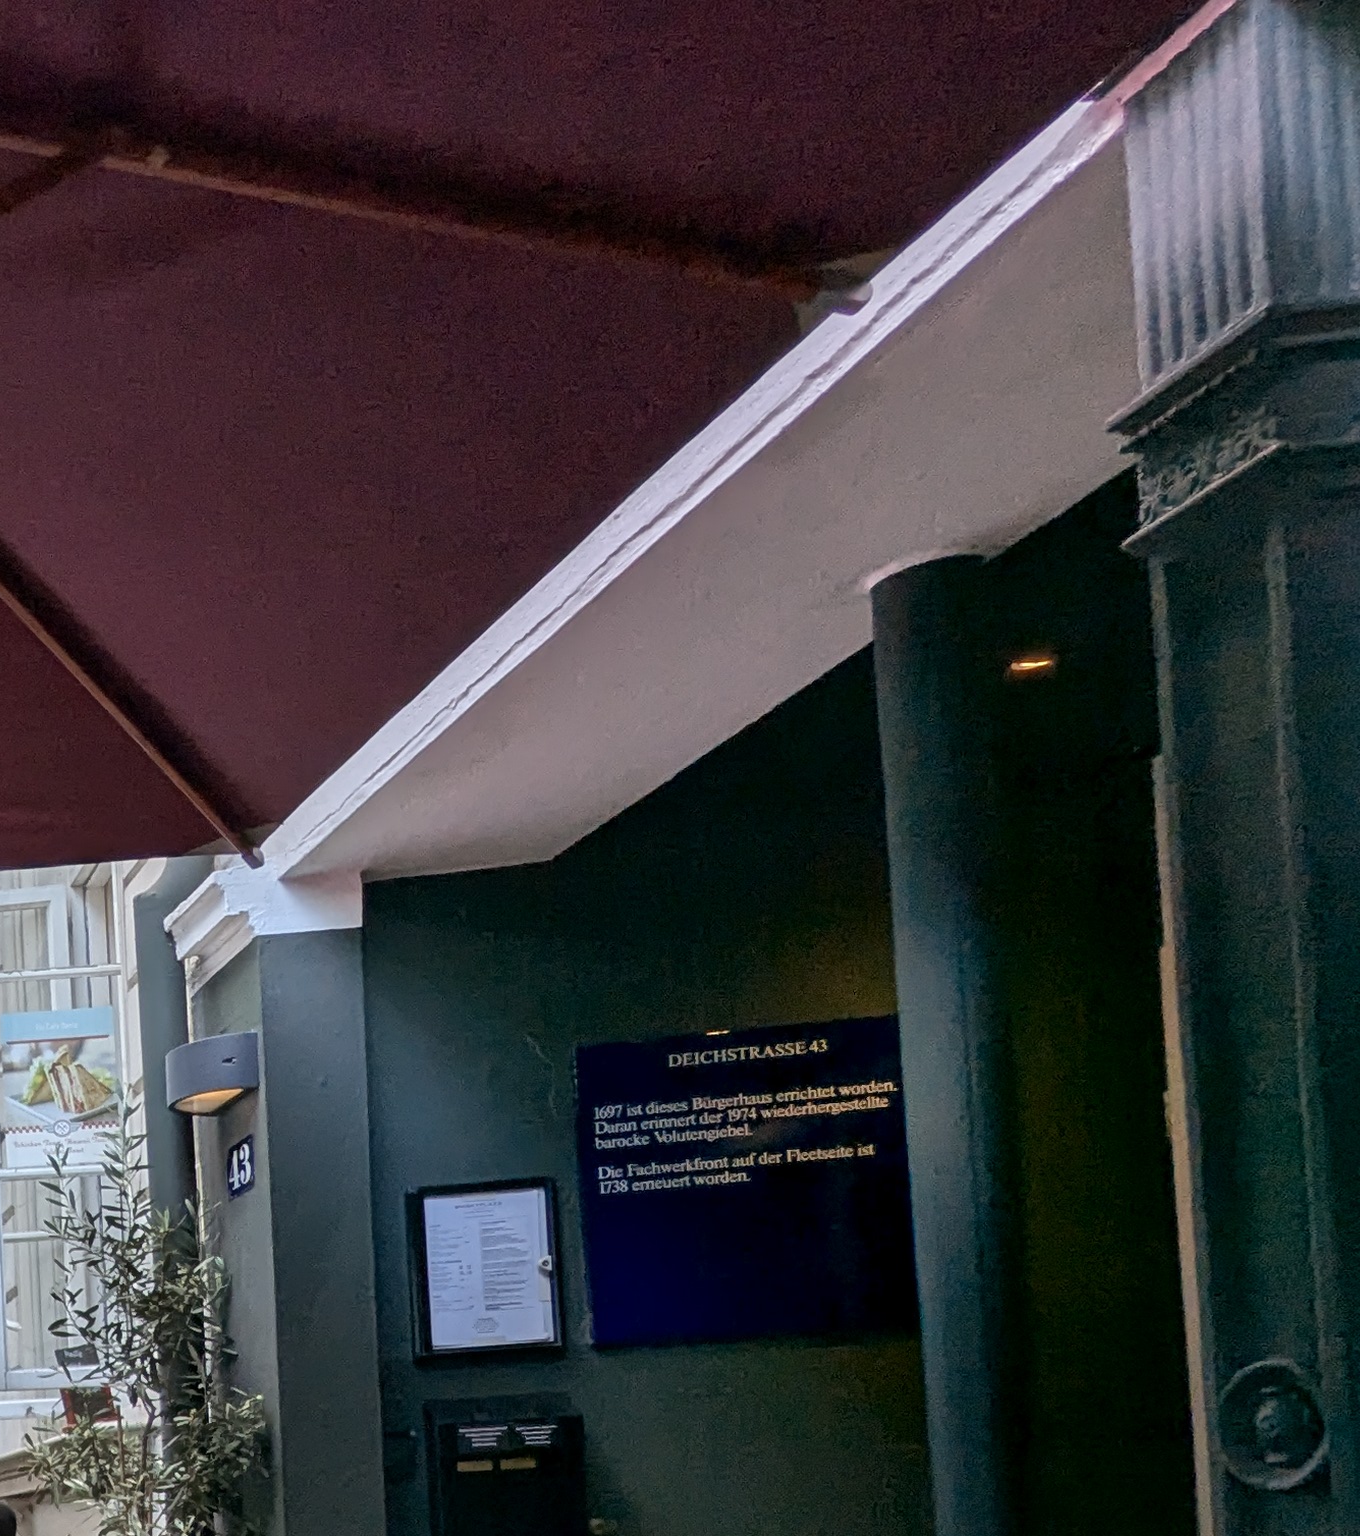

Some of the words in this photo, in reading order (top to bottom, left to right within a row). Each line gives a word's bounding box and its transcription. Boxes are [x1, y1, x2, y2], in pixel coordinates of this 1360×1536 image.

[668, 1041, 808, 1067] DEICHSTRASSE
[809, 1039, 828, 1053] 43
[593, 1104, 623, 1120] 1697
[626, 1102, 643, 1117] ist
[645, 1100, 689, 1115] dieses
[692, 1092, 773, 1112] Bürgerhaus
[775, 1086, 836, 1103] errichtet
[839, 1080, 899, 1096] worden.
[640, 1115, 697, 1131] erinnert
[699, 1111, 723, 1125] der
[727, 1107, 757, 1122] 1974
[760, 1096, 890, 1119] wiederhergestellte
[594, 1133, 650, 1150] barocke
[228, 1143, 252, 1191] 43
[597, 1165, 624, 1180] Die
[626, 1157, 729, 1177] Fachwerkfront
[732, 1152, 757, 1168] auf
[758, 1151, 783, 1166] der
[786, 1145, 855, 1163] Fleetseite
[856, 1143, 876, 1157] ist
[599, 1179, 629, 1195] 1738
[631, 1175, 691, 1192] erneuert
[692, 1169, 752, 1186] worden.
